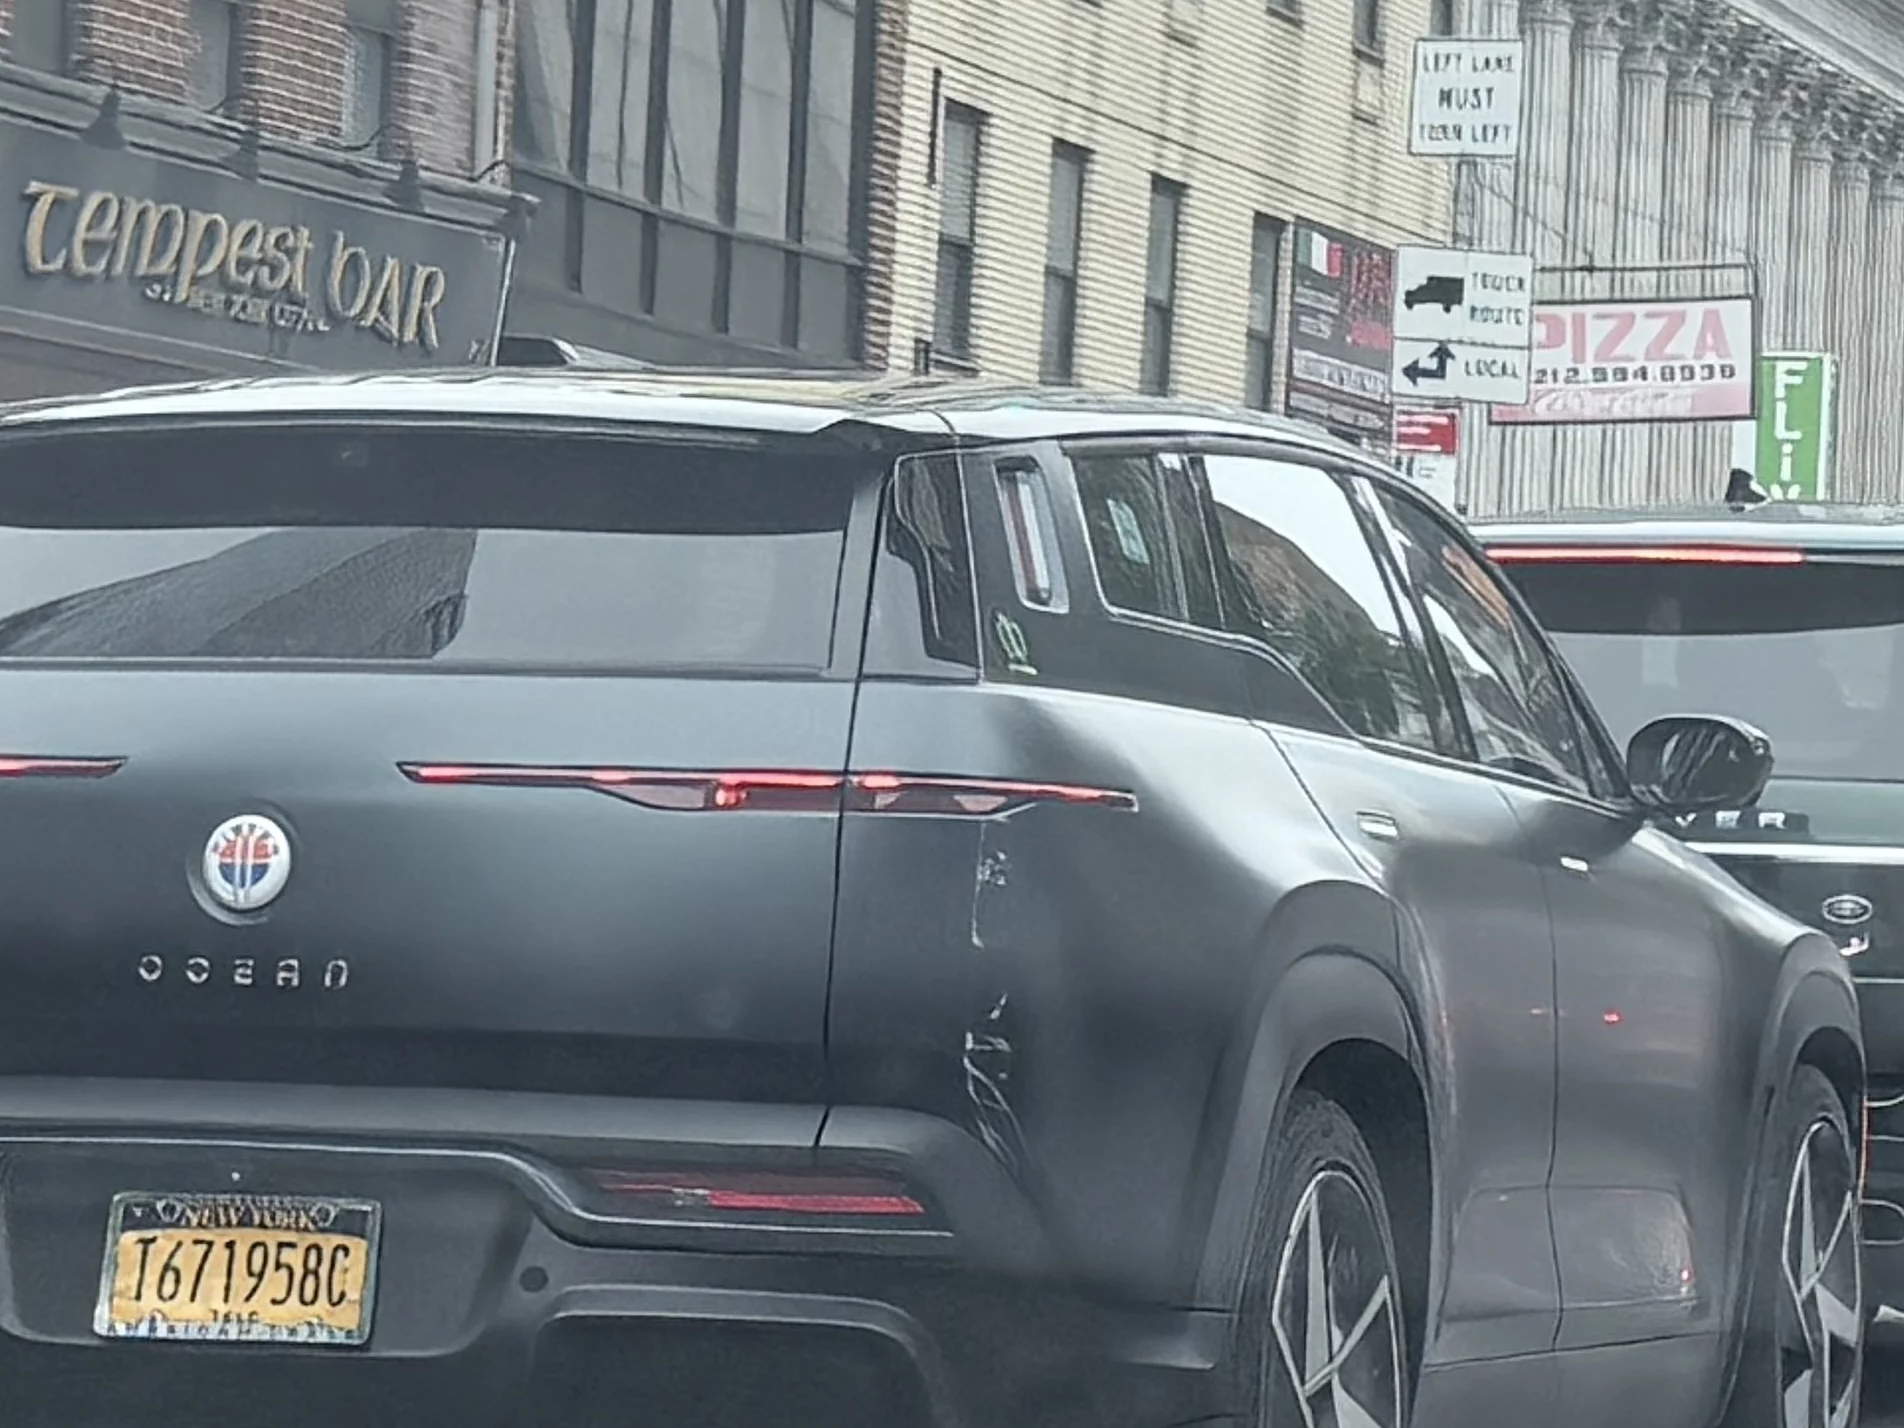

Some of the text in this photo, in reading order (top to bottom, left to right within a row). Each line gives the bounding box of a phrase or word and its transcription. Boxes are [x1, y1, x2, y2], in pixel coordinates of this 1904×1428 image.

[1438, 86, 1494, 110] MUST
[1469, 304, 1524, 326] ROUTE
[1533, 307, 1733, 364] PIZZA
[1463, 358, 1520, 379] LOCAL
[179, 1202, 318, 1231] NEW YORK
[133, 1235, 351, 1308] T671958C
